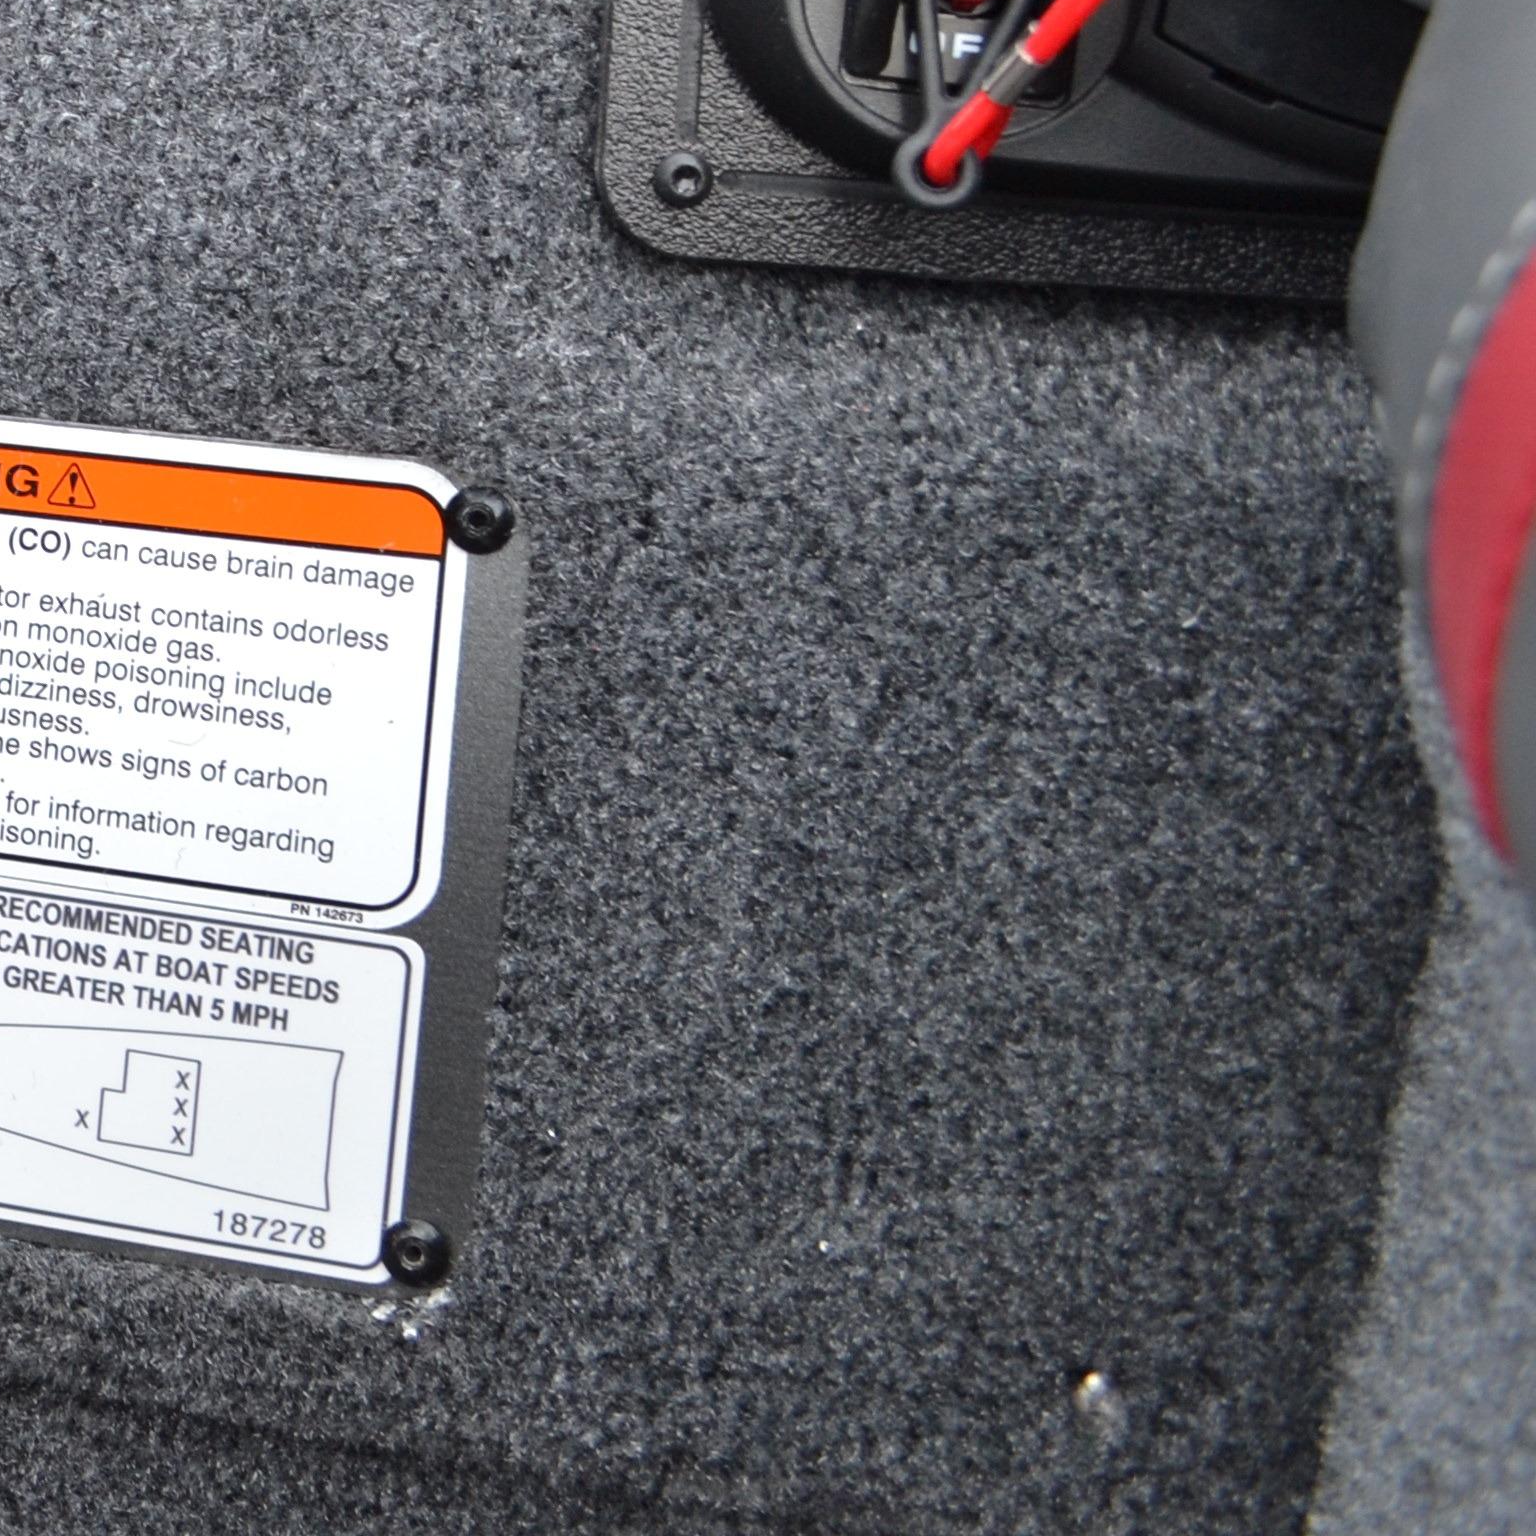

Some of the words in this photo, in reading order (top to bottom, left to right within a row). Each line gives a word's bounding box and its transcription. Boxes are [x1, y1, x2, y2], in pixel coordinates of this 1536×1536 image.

[7, 526, 71, 560] (CO)
[81, 539, 129, 561] can
[137, 546, 217, 572] cause
[226, 550, 293, 579] brain
[303, 560, 414, 596] damage
[27, 622, 157, 655] monoxide
[165, 638, 220, 664] gas.
[38, 592, 141, 623] exhaust
[150, 606, 263, 637] contains
[272, 619, 389, 652] odorless
[94, 660, 225, 699] poisoning
[234, 671, 332, 706] include
[133, 690, 291, 733] drowsiness,
[28, 736, 112, 768] shows
[120, 749, 191, 781] signs
[200, 759, 227, 782] of
[233, 766, 328, 796] carbon
[5, 789, 41, 816] for
[48, 798, 195, 838] information
[204, 823, 334, 864] regarding
[289, 901, 311, 917] PN
[315, 906, 364, 924] 142673
[199, 925, 314, 965] SEATING
[2, 964, 125, 1006] GREATER
[132, 984, 203, 1018] THAN
[209, 997, 225, 1021] 5
[231, 1000, 289, 1032] MPH
[112, 948, 149, 974] AT
[155, 953, 229, 986] BOAT
[234, 966, 340, 1004] SPEEDS
[213, 1209, 327, 1250] 187278
